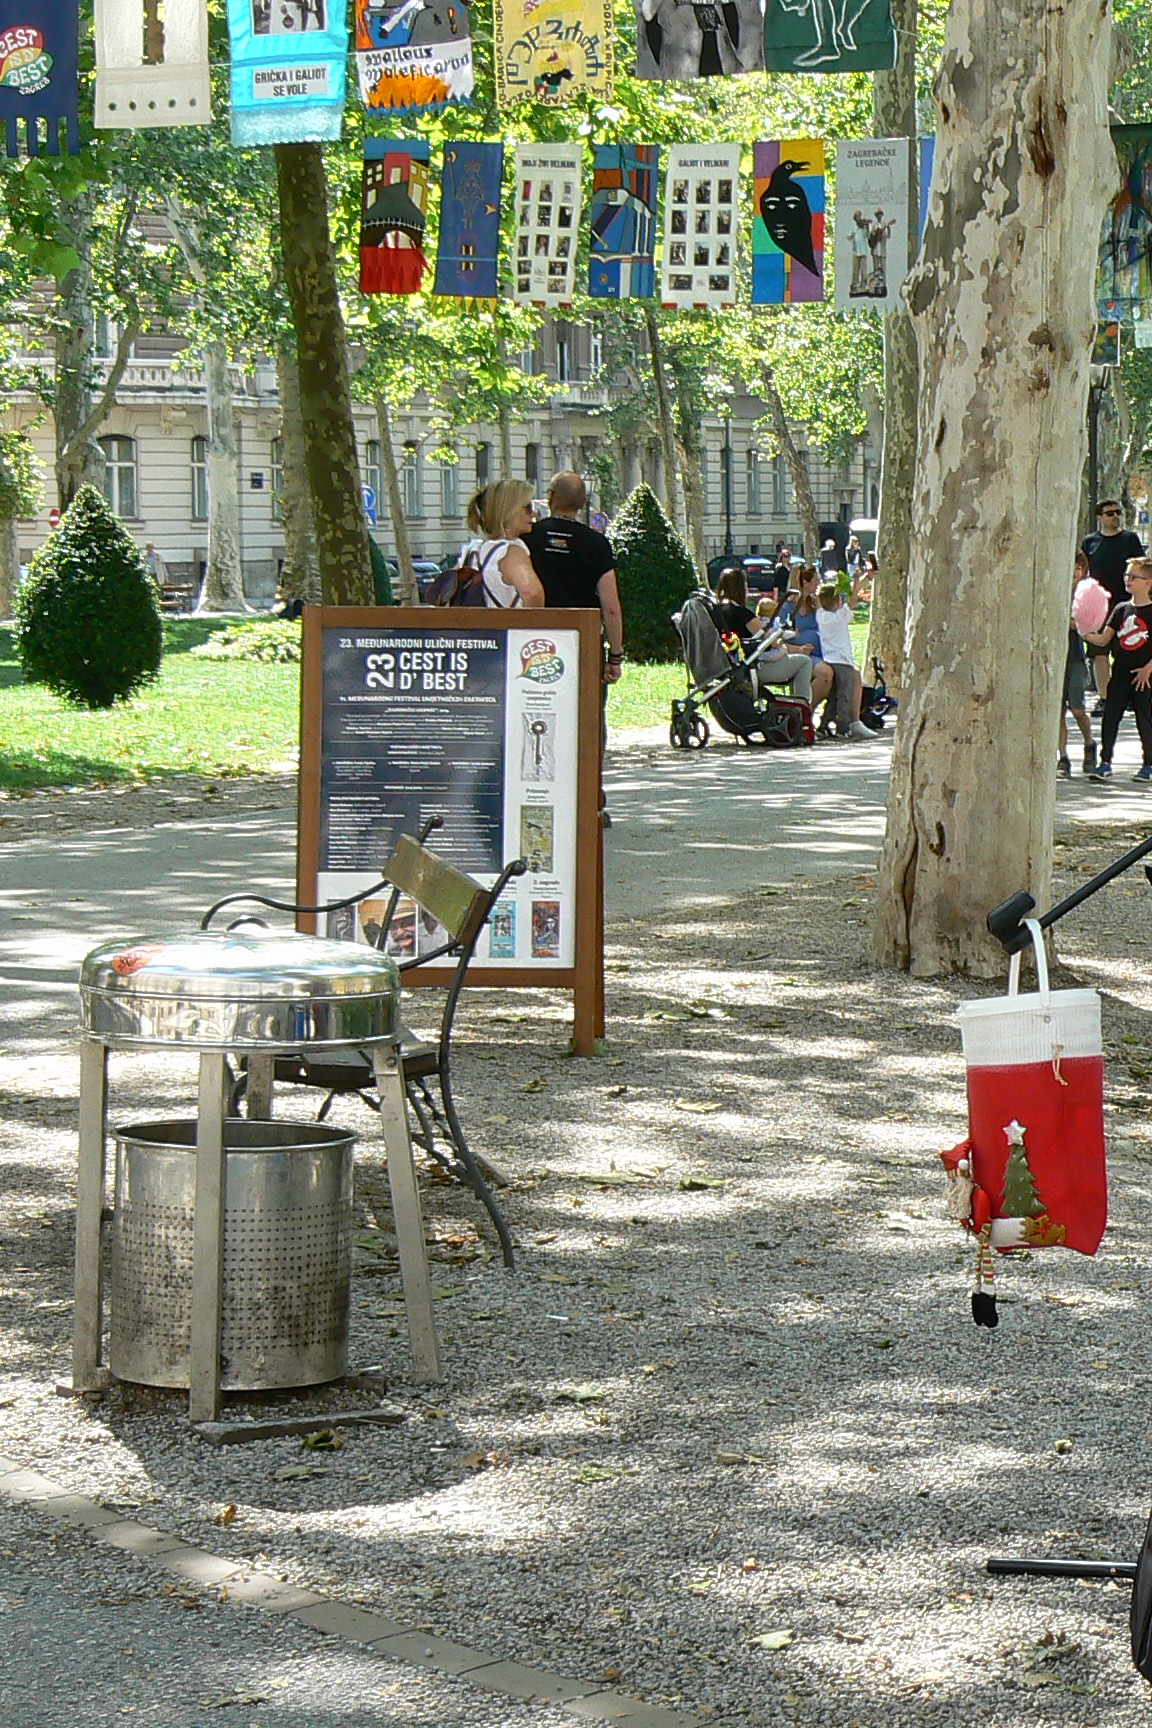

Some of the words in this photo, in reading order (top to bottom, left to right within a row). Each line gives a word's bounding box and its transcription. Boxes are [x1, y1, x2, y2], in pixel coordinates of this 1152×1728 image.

[0, 29, 38, 59] CEST
[7, 56, 48, 87] BEST
[255, 70, 288, 84] GRIČKA
[295, 68, 327, 81] GALIOT
[273, 86, 285, 96] SE
[287, 83, 308, 96] VOLE
[855, 159, 890, 168] LEGENDE
[339, 639, 354, 649] 23.
[356, 639, 422, 649] MEĐUNARODNI
[425, 637, 454, 649] ULIČNI
[456, 639, 499, 650] FESTIVAL
[522, 641, 553, 659] CEST
[367, 653, 395, 689] 23
[400, 652, 446, 671] CEST
[450, 652, 468, 671] IS
[529, 659, 561, 678] BEST
[400, 672, 418, 690] D'
[423, 672, 468, 691] BEST
